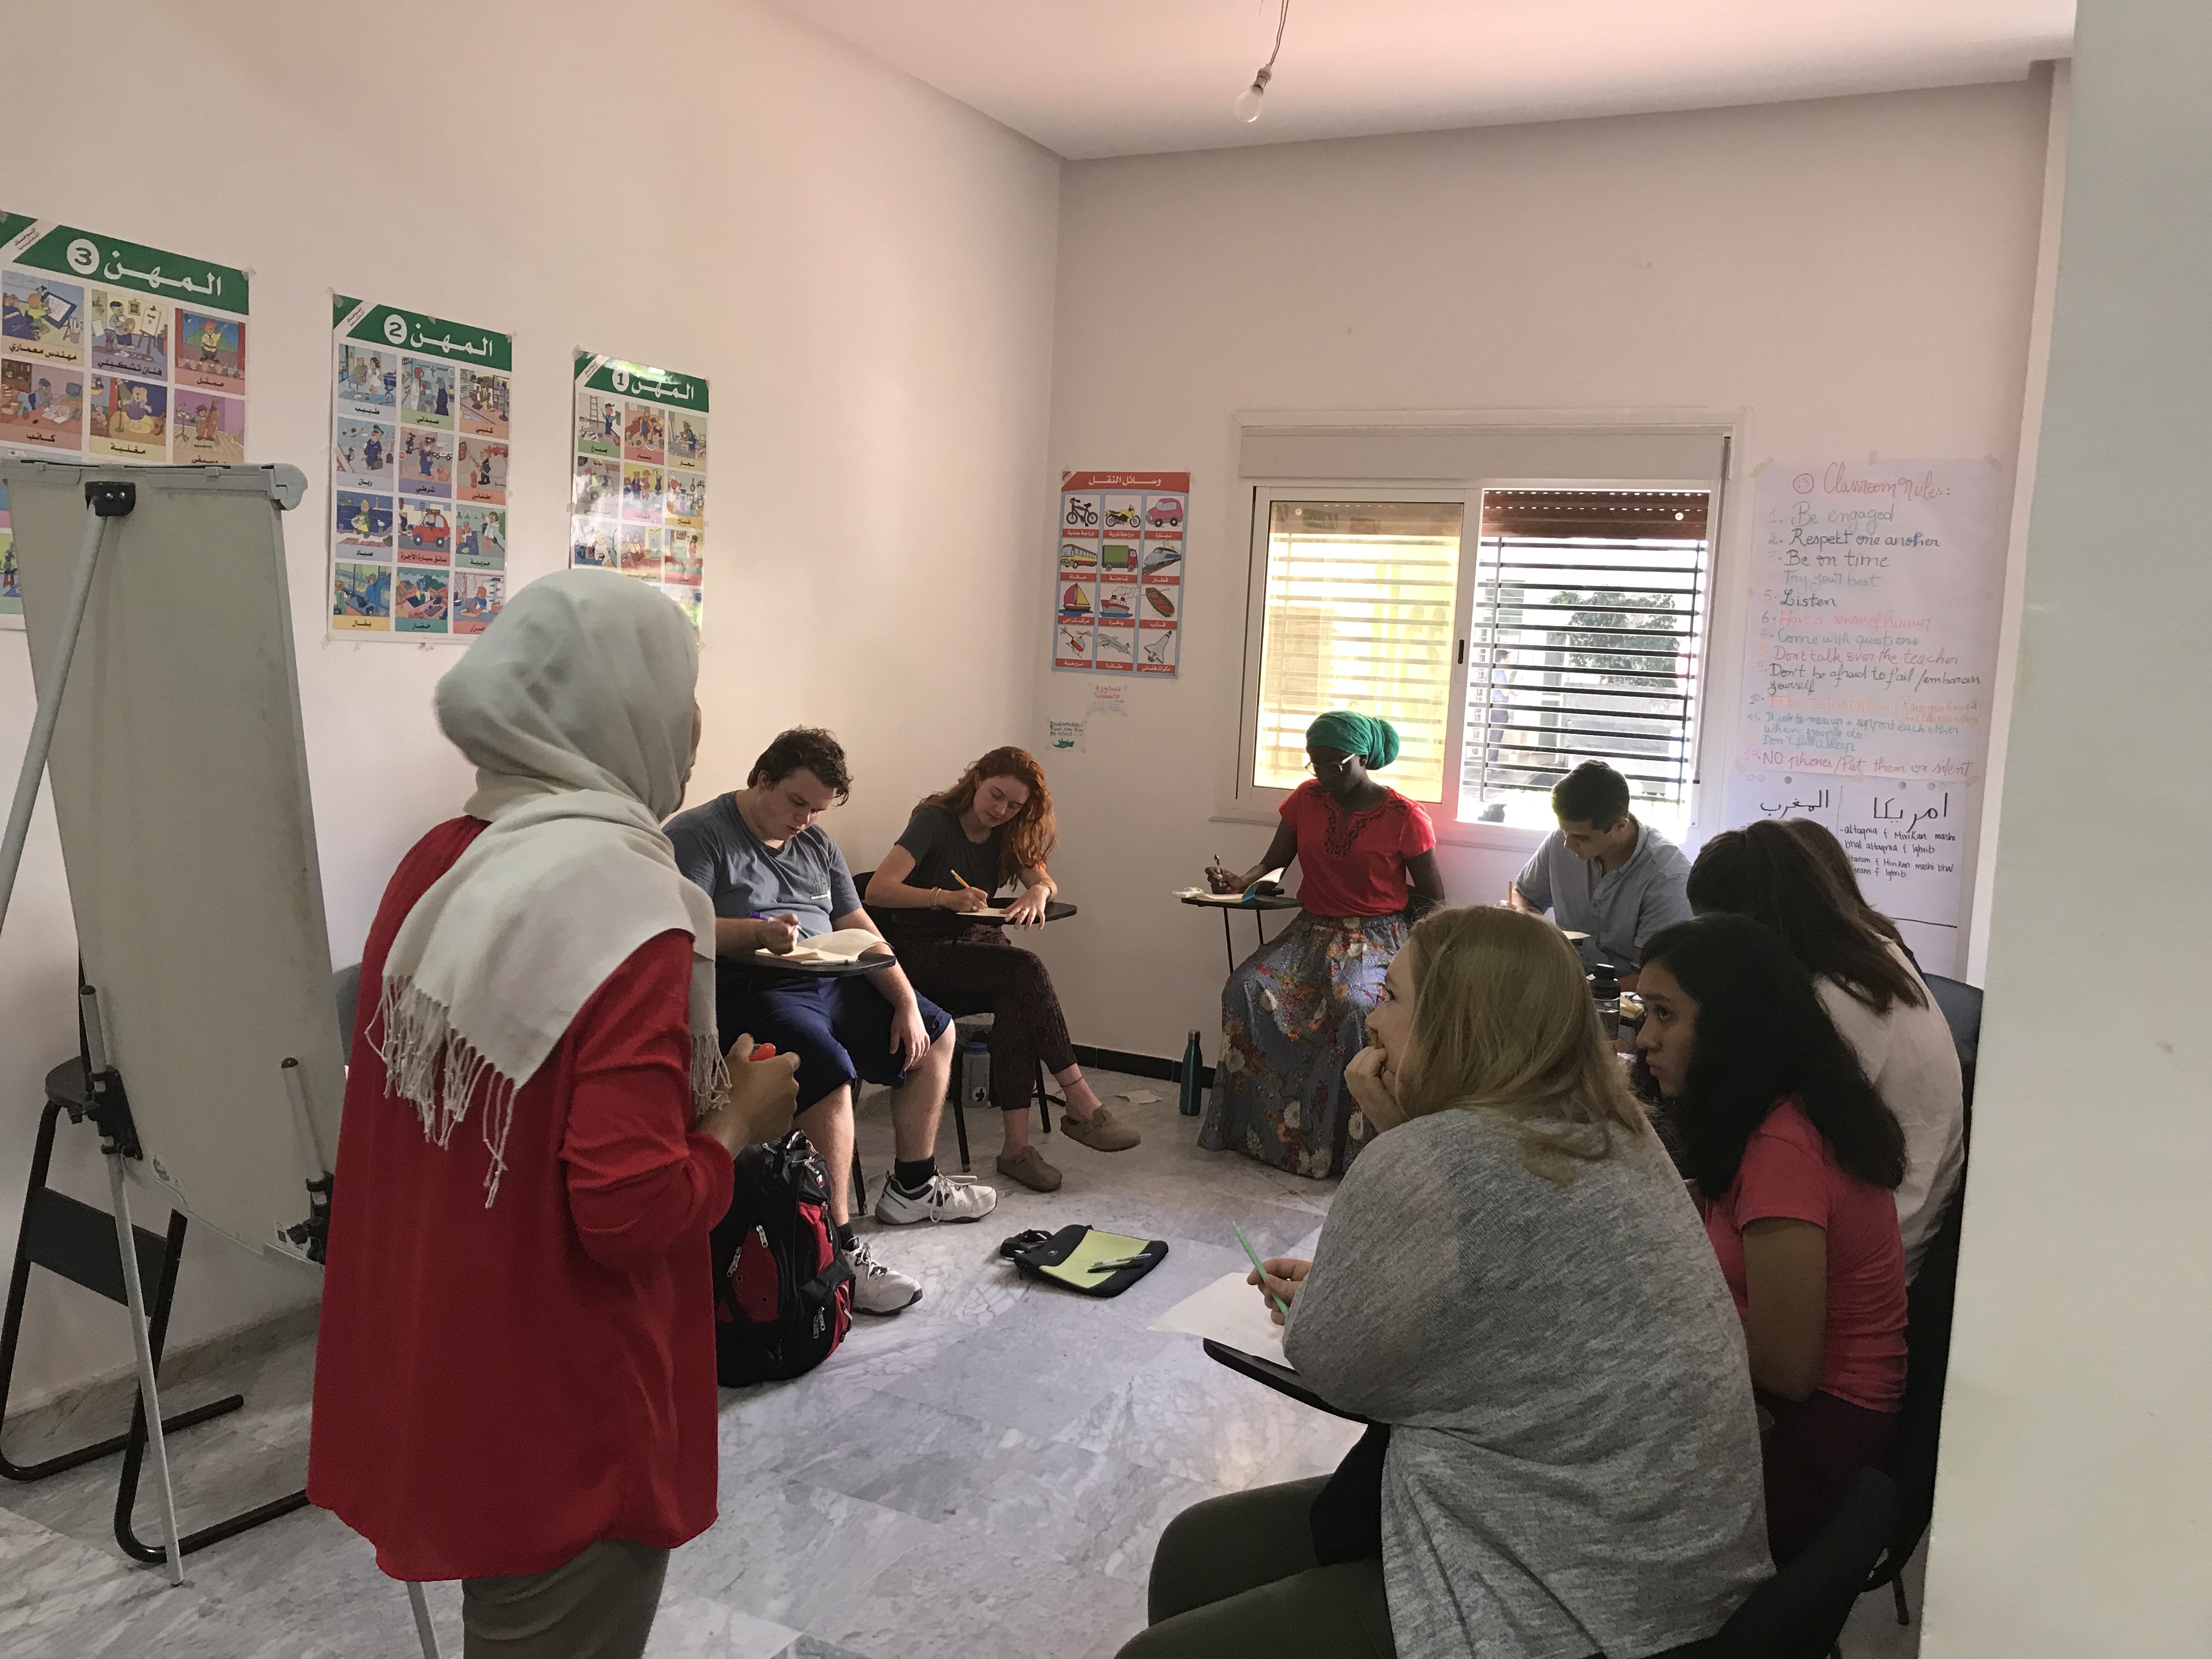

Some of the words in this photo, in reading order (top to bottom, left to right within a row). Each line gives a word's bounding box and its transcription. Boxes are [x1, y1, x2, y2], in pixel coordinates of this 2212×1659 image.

[74, 246, 92, 266] 3
[104, 250, 221, 296] المهن
[389, 321, 402, 337] 2
[9, 342, 43, 356] معماري
[410, 323, 493, 357] المهن
[45, 348, 77, 360] مهندس
[617, 373, 624, 386] 1
[1088, 475, 1121, 485] النقل
[1122, 476, 1161, 487] وسائل
[1824, 462, 1896, 497] Classroom
[1791, 501, 1819, 527] Be
[1828, 503, 1894, 535] engaged
[1856, 534, 1880, 546] one
[1784, 549, 1811, 567] Be
[1816, 554, 1836, 567] on
[1844, 549, 1891, 567] time
[1780, 589, 1838, 607] Listen
[1779, 610, 1810, 626] Have
[1778, 628, 1818, 645] Come
[1822, 633, 1850, 645] with
[1856, 631, 1919, 651] questions
[1810, 647, 1844, 664] talk
[1847, 651, 1875, 663] over
[1878, 646, 1899, 665] the
[1903, 646, 1959, 666] teacher
[1769, 662, 1807, 678] Don't
[1812, 665, 1825, 679] be
[1830, 663, 1867, 687] afraid
[1871, 666, 1886, 680] to
[1883, 667, 1915, 690] fail
[1767, 679, 1815, 696] yourself
[1897, 723, 1925, 733] each
[1927, 724, 1960, 735] other
[1763, 750, 1784, 764] NO
[1787, 751, 1832, 770] phones
[1872, 754, 1906, 775] them
[1931, 758, 1974, 777] silent
[1760, 789, 1829, 820] المغرب
